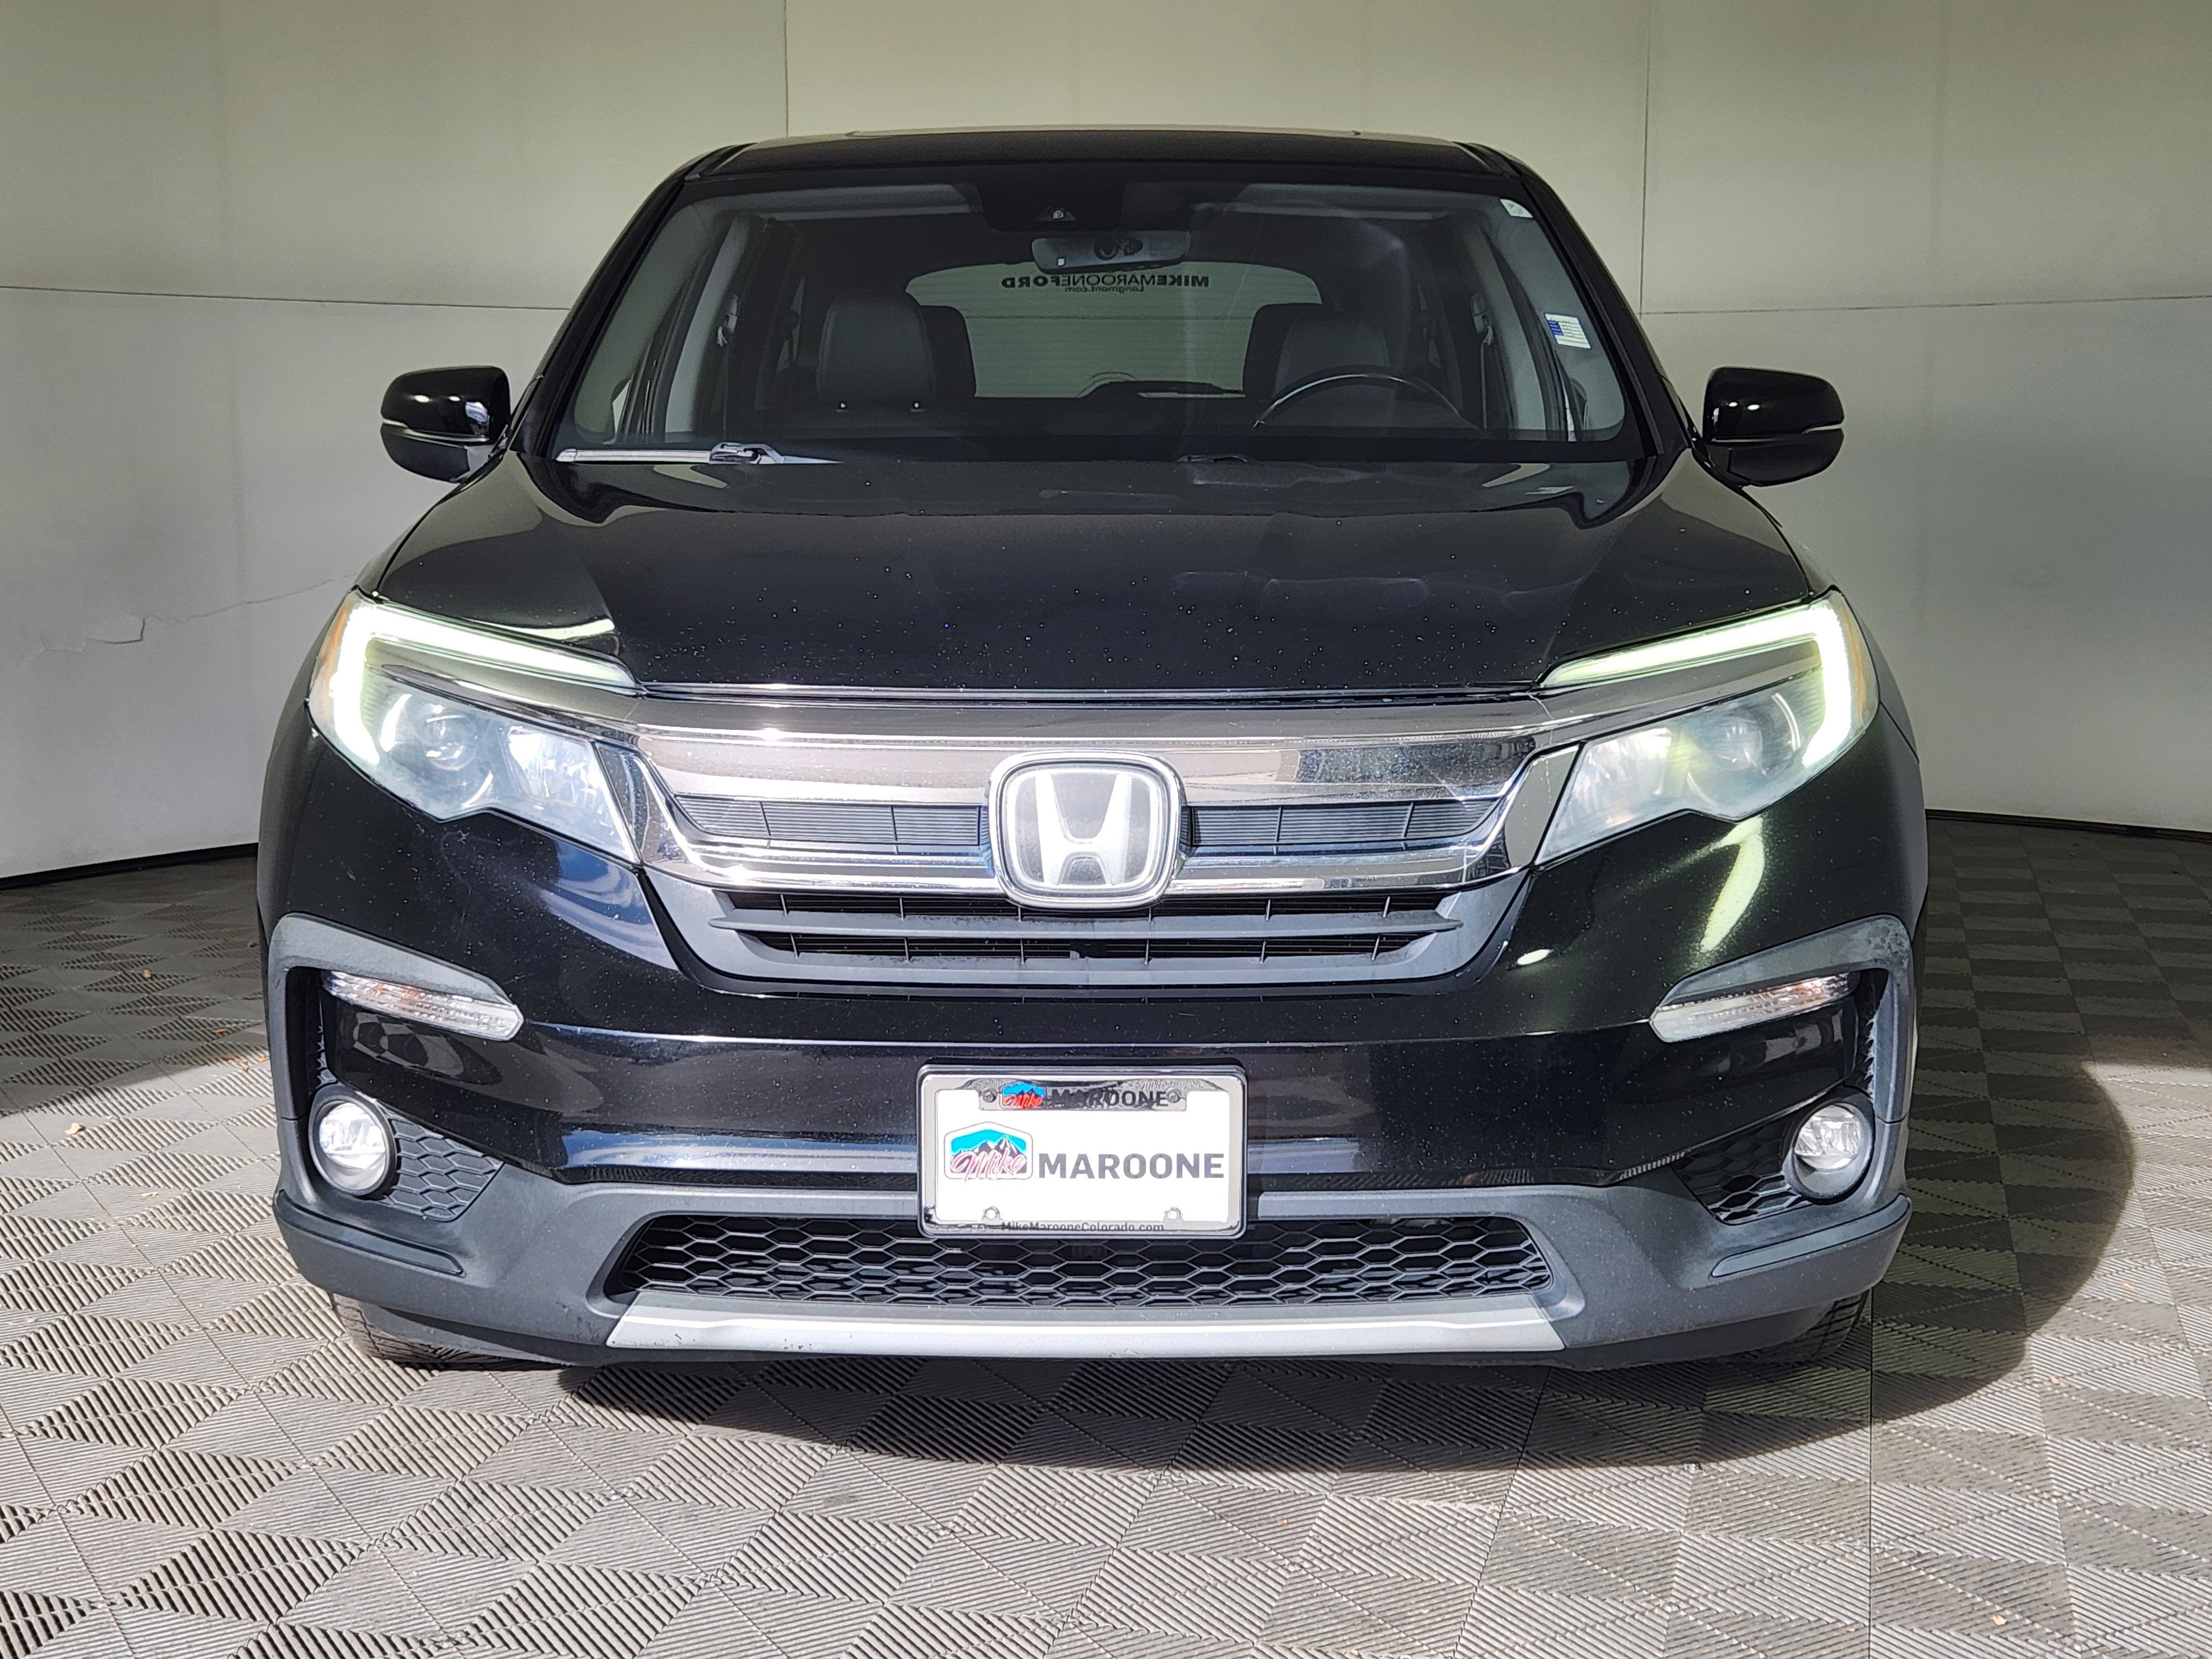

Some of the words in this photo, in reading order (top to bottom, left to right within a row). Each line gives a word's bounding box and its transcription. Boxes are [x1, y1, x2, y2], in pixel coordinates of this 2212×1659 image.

[1052, 1088, 1169, 1107] MAROONE
[951, 1147, 1027, 1182] Mike
[1039, 1152, 1224, 1179] MAROONE
